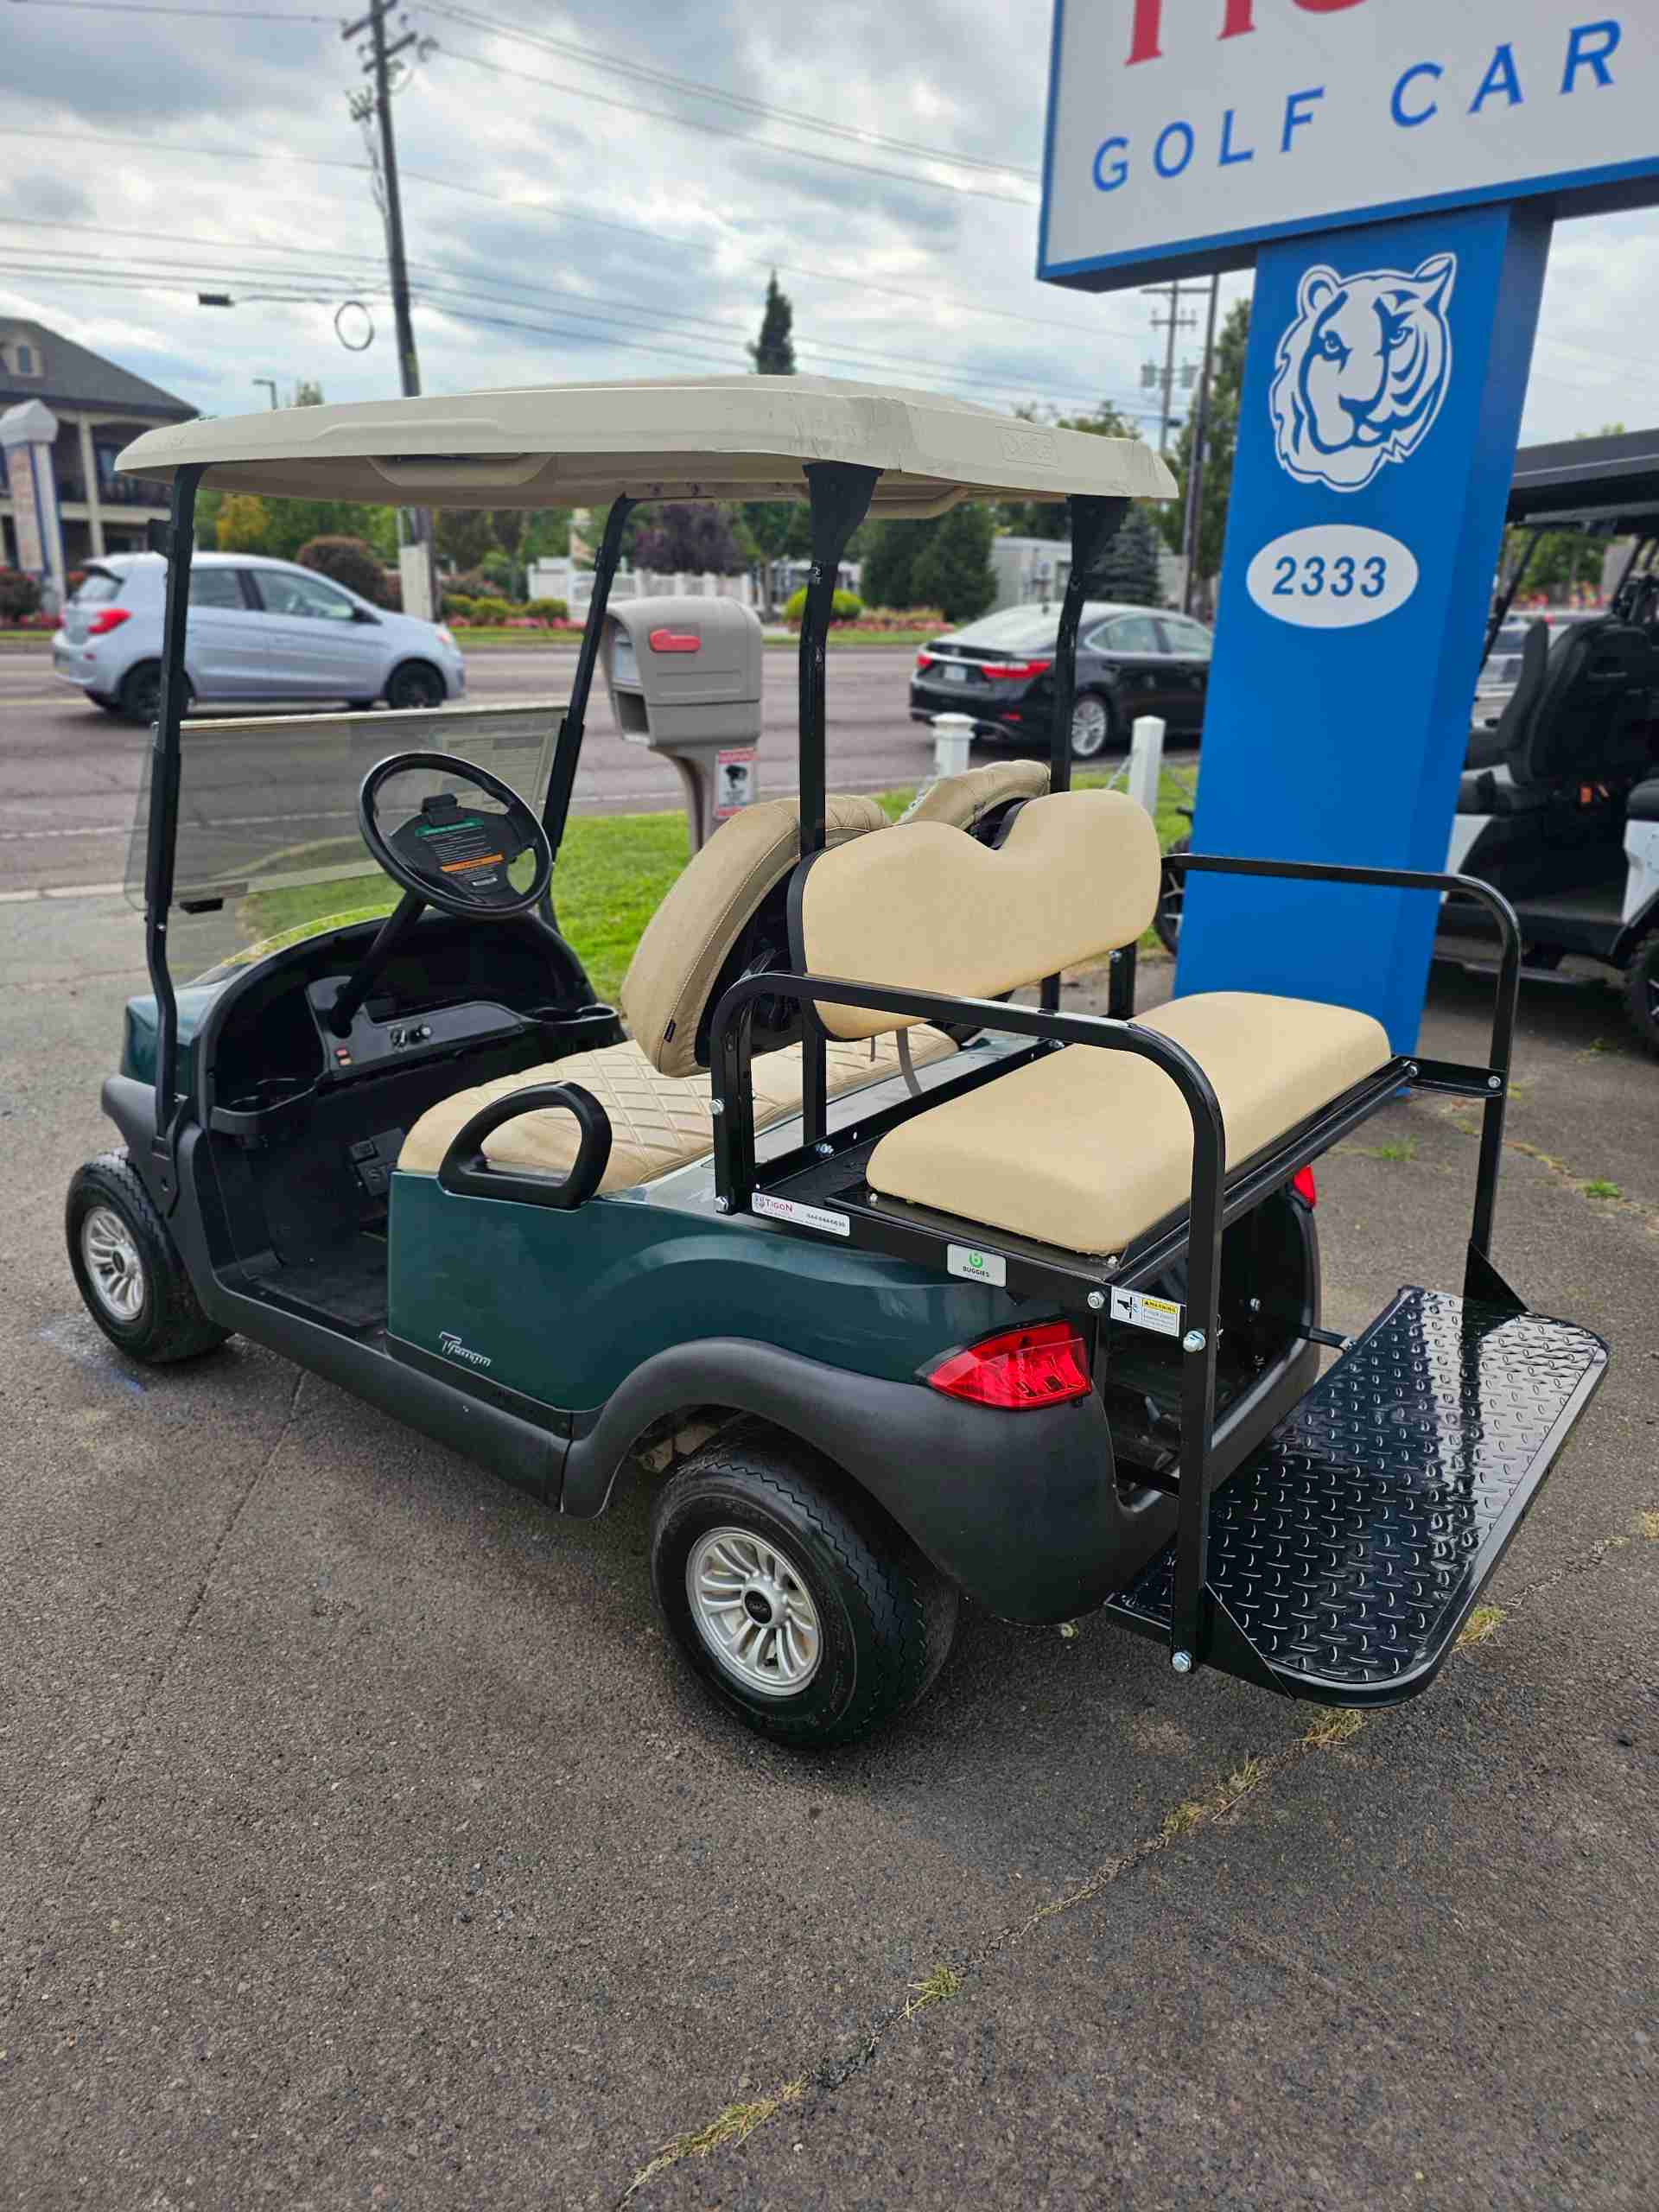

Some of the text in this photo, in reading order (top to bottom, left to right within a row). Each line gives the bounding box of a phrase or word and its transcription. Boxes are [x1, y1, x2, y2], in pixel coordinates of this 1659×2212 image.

[1091, 86, 1325, 192] GOLF
[1389, 20, 1622, 128] CAR
[1271, 556, 1389, 598] 2333
